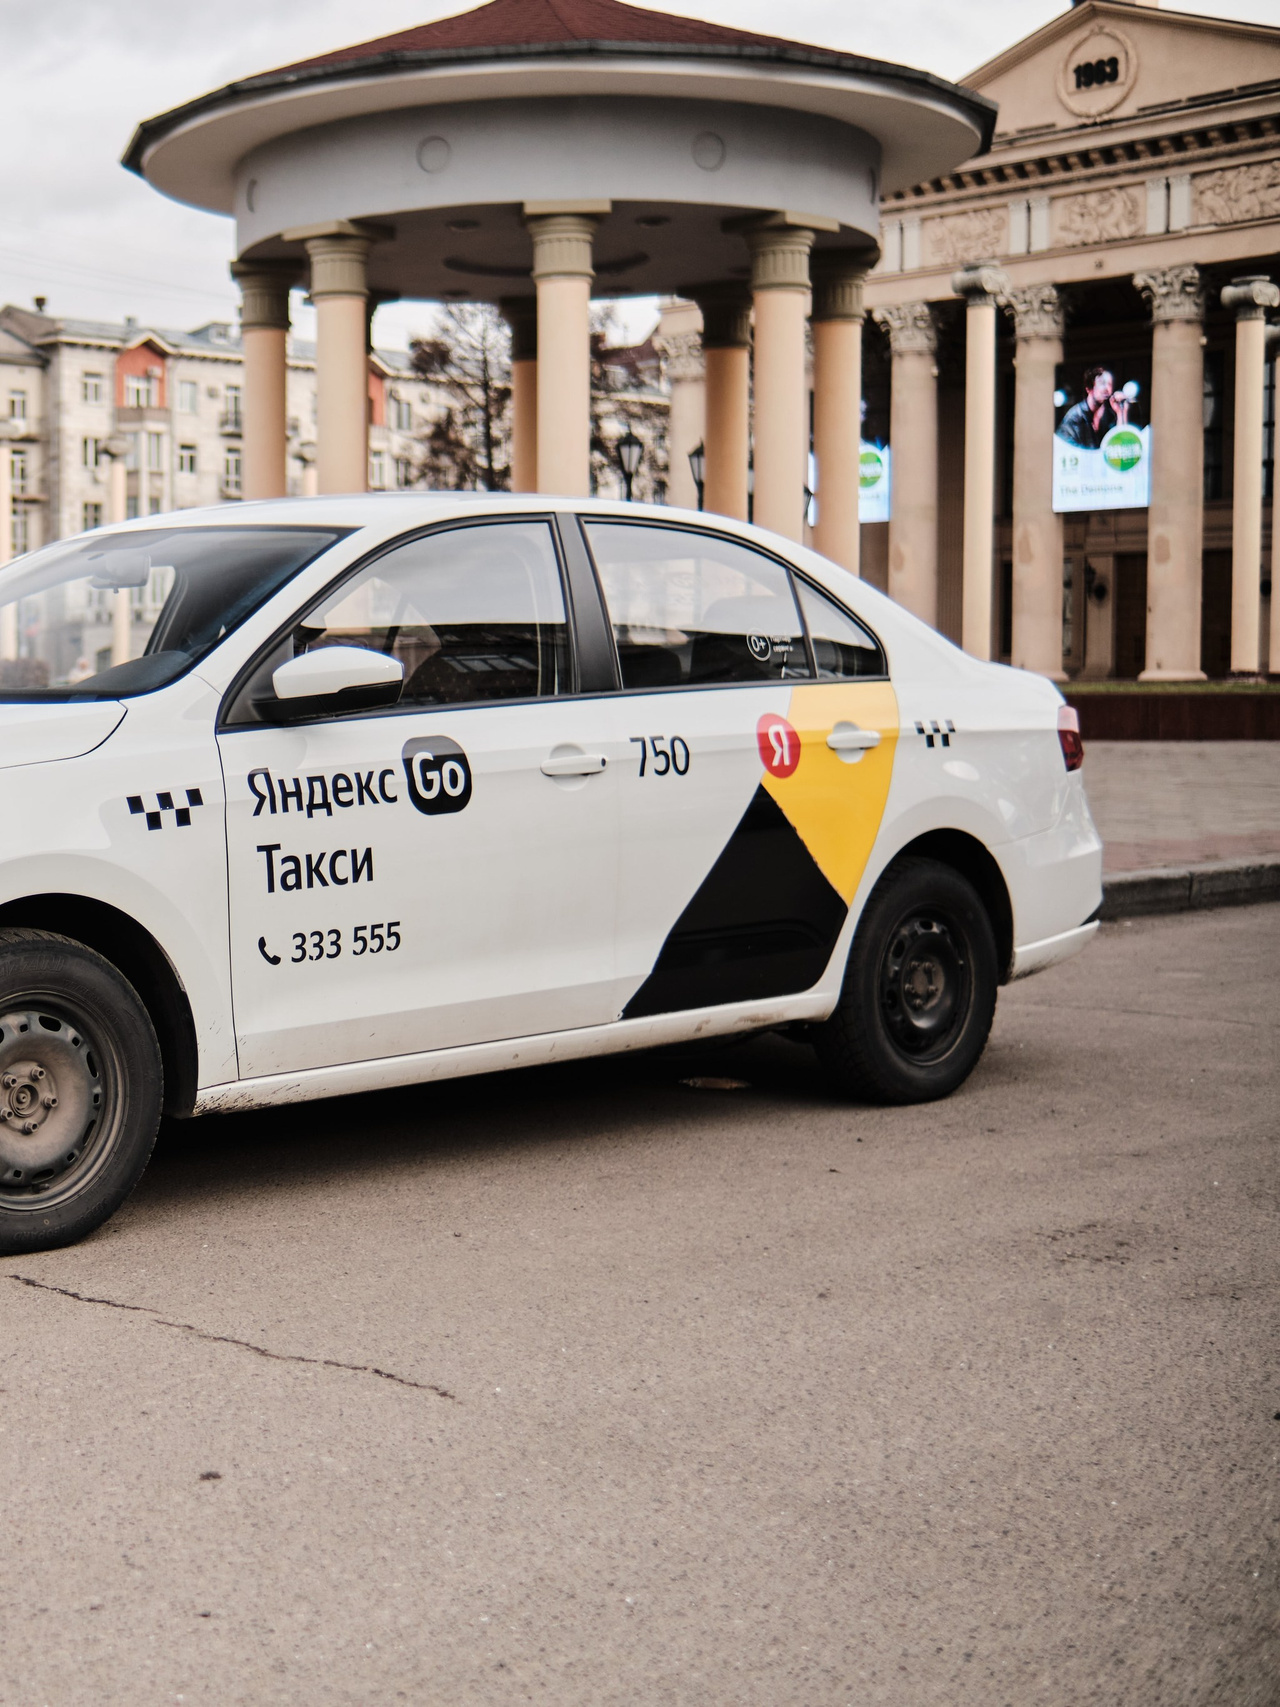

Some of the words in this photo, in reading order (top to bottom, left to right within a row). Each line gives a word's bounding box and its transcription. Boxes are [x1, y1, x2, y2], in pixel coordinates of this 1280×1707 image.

[630, 736, 690, 776] 750
[768, 724, 791, 767] Я
[247, 767, 398, 818] Яндекс
[412, 751, 465, 800] Go
[257, 843, 374, 893] Такси
[291, 928, 342, 962] 333
[352, 921, 401, 955] 555
